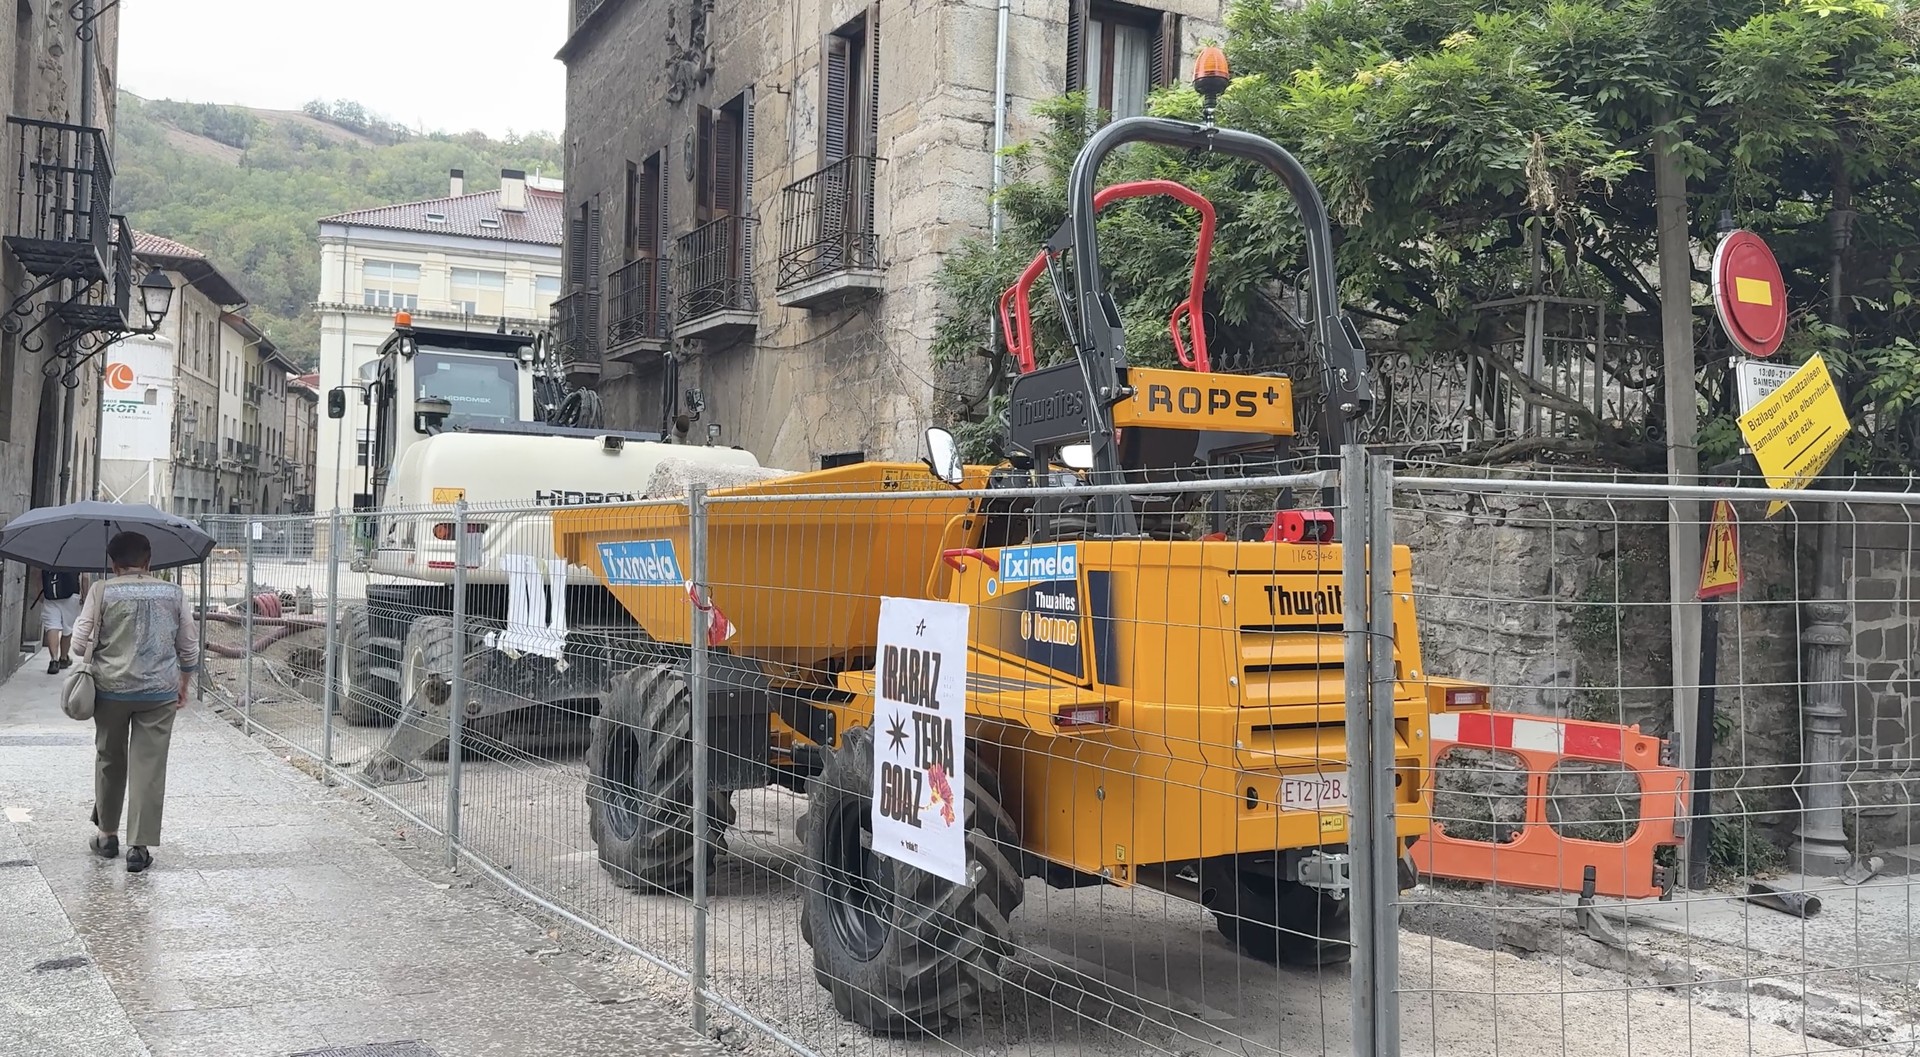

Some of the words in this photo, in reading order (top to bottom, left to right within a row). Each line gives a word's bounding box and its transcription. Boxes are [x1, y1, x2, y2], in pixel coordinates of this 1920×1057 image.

[1015, 389, 1084, 427] Thwaites
[1149, 384, 1279, 418] ROPS+
[1747, 402, 1781, 432] Bizilagun
[1782, 366, 1821, 404] banatzaileen
[1753, 417, 1789, 452] zamalanak
[1788, 410, 1799, 423] eta
[1799, 379, 1832, 413] elbarrituak
[1786, 430, 1801, 447] izan
[1800, 418, 1816, 435] ezik.
[602, 542, 677, 580] Tximela
[1003, 546, 1074, 578] Tximela
[1035, 591, 1076, 612] Thwaites
[1263, 585, 1343, 616] Thwait
[1034, 610, 1078, 647] tonne
[882, 644, 941, 710] IRABAZ
[911, 710, 954, 778] TERA
[879, 761, 923, 829] GOAZ
